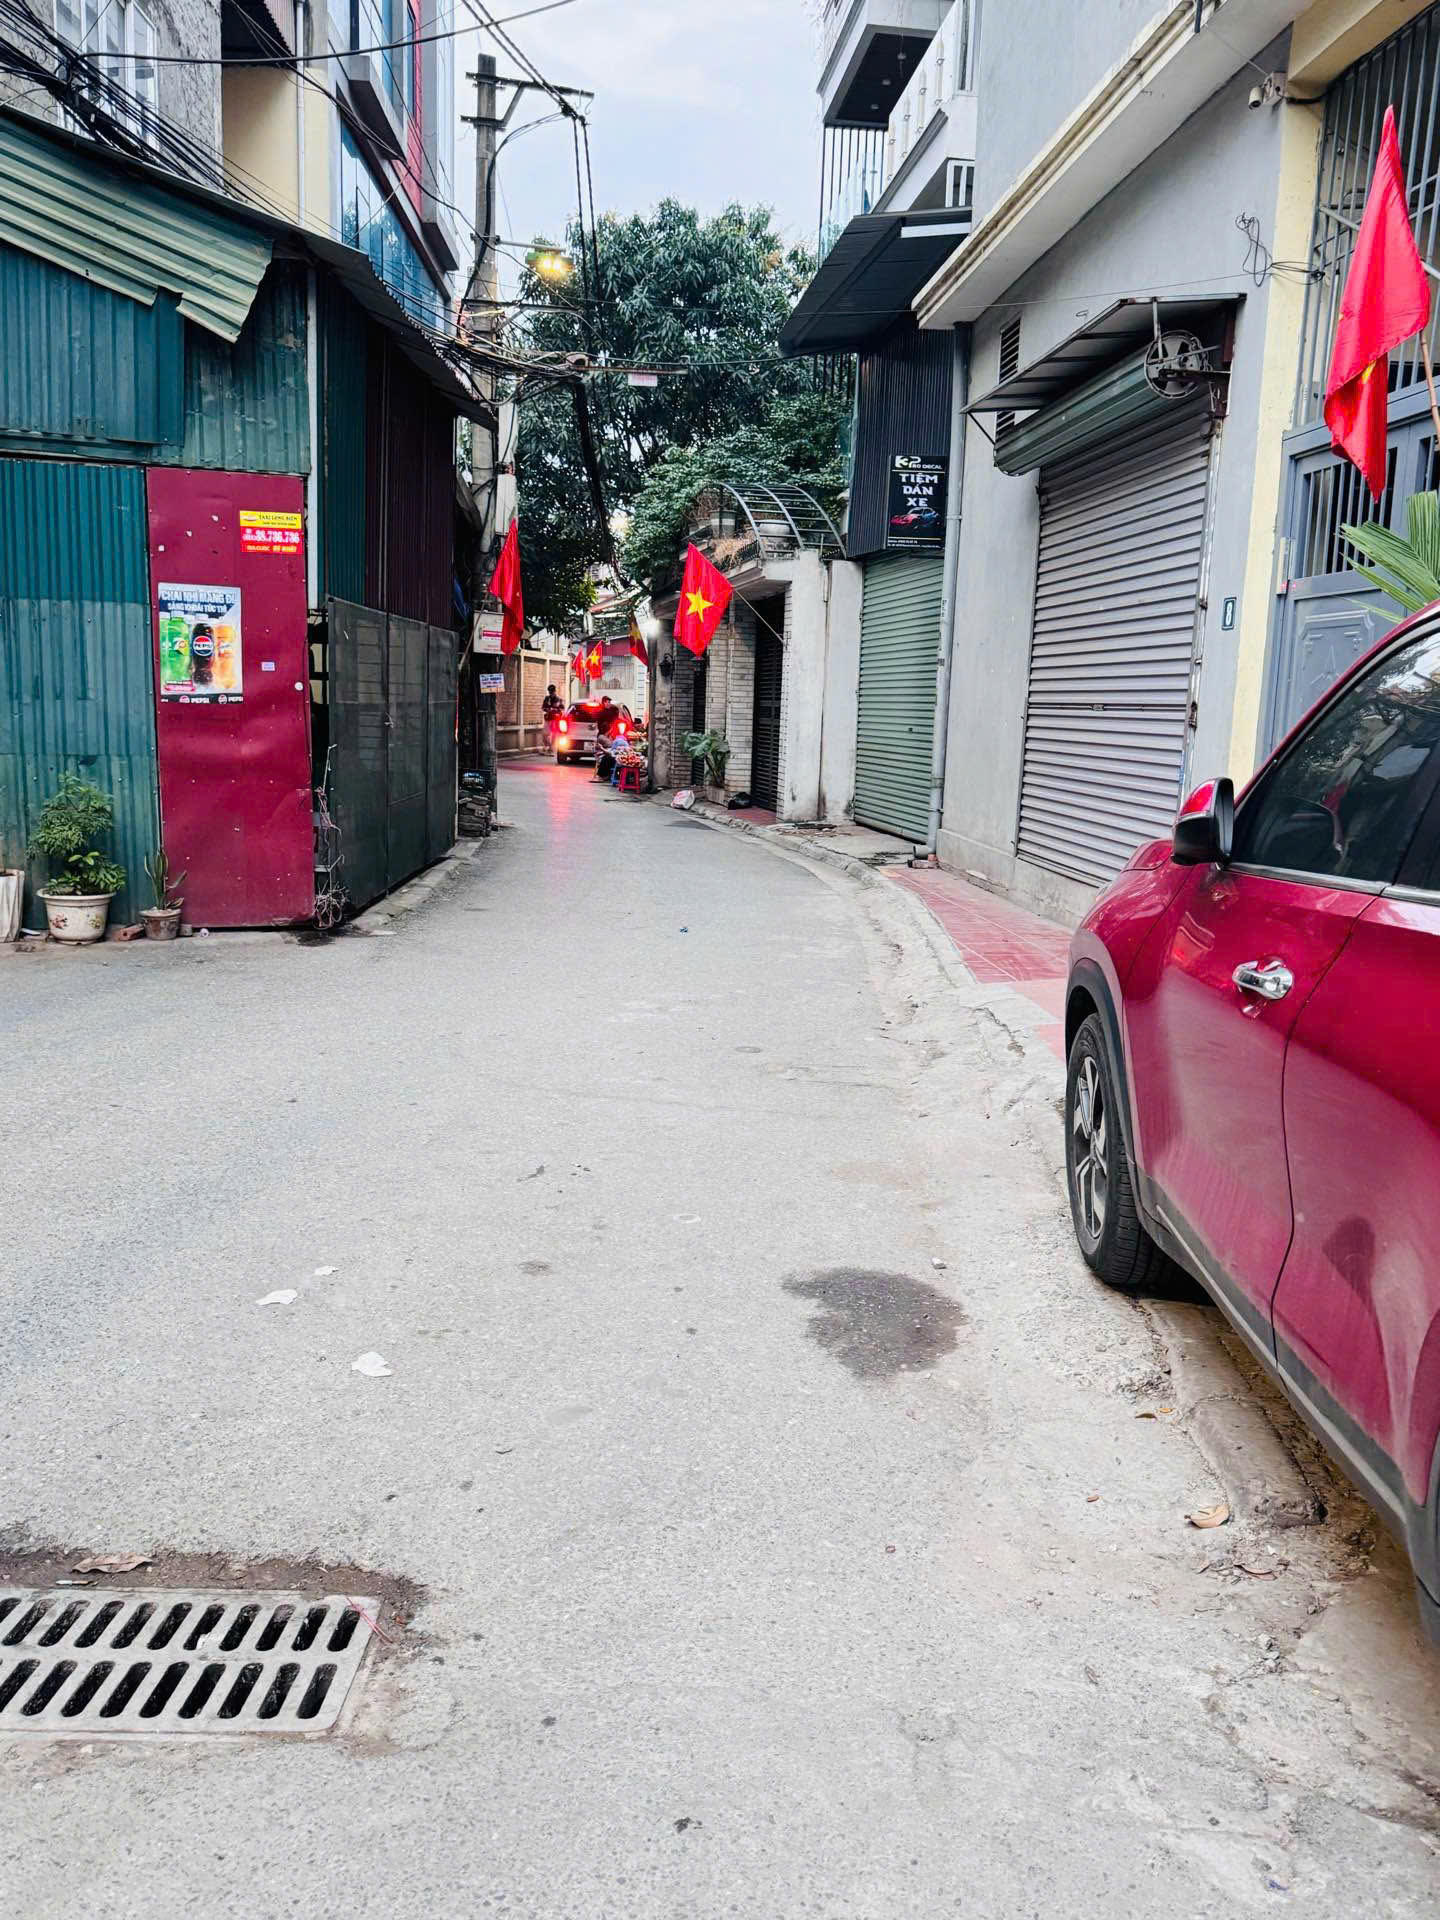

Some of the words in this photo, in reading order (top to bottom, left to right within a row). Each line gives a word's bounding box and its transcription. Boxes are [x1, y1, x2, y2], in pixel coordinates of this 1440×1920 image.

[899, 472, 938, 484] TIỆM
[902, 484, 934, 495] DÁN
[906, 497, 928, 507] XE
[1225, 601, 1233, 626] 8
